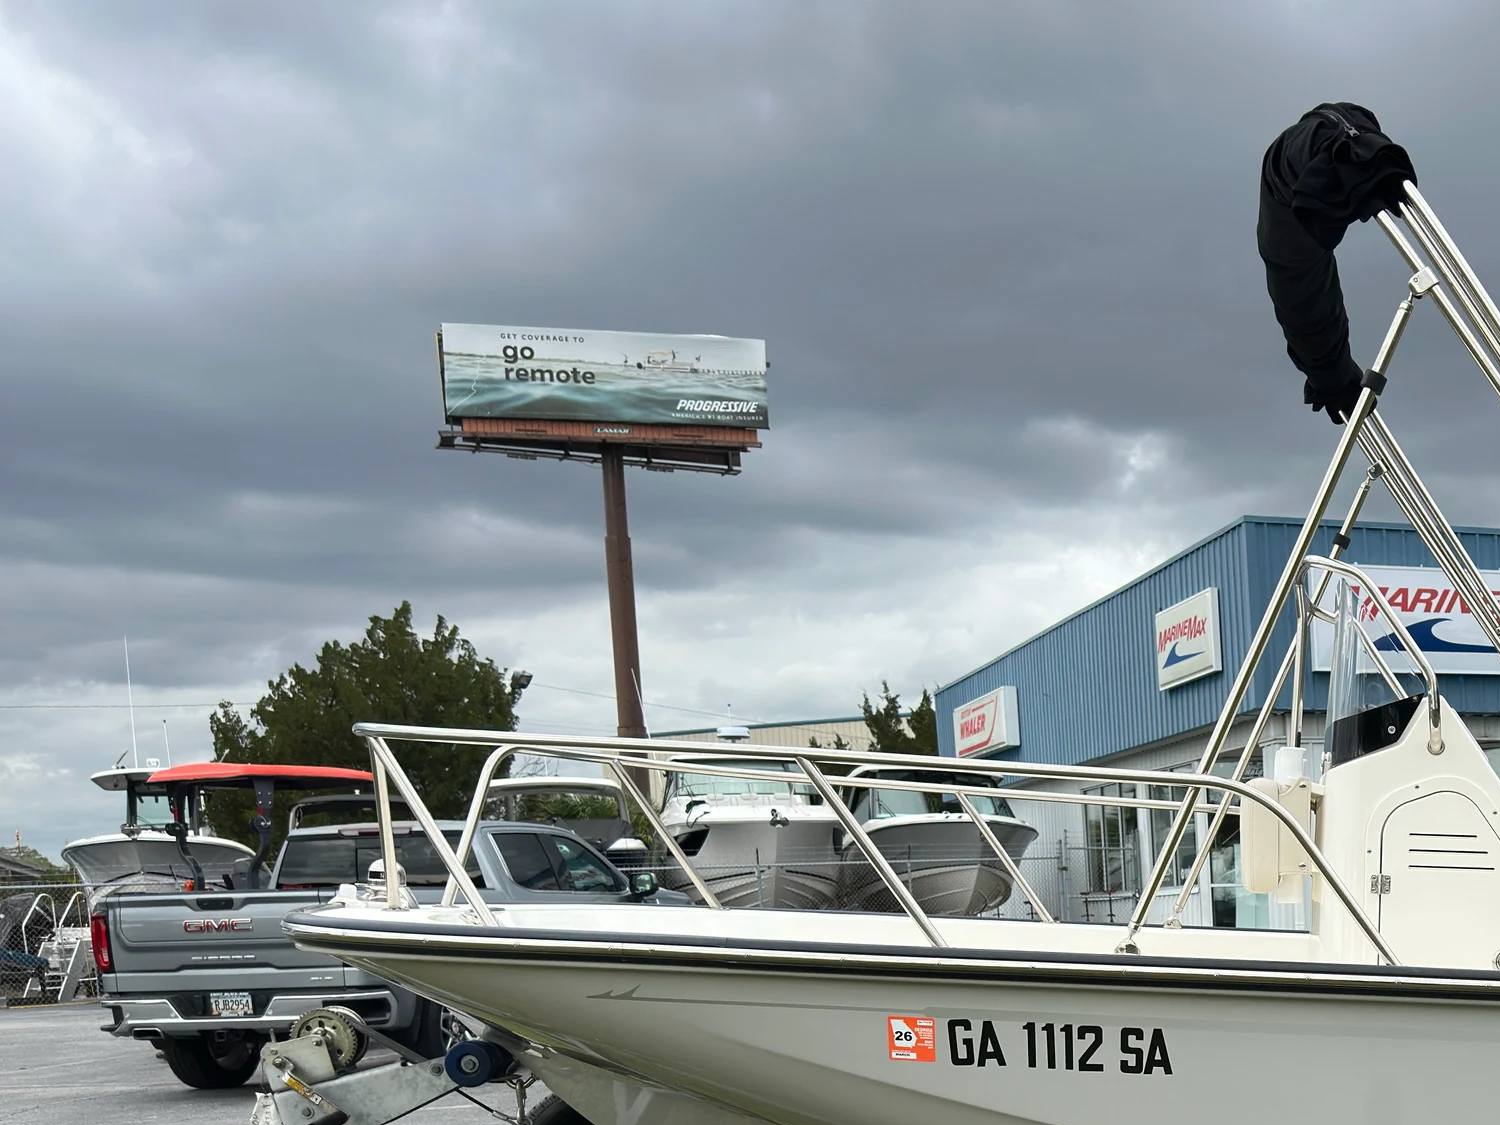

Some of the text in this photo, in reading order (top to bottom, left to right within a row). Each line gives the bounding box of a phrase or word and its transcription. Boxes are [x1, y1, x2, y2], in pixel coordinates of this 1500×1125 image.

[521, 334, 569, 342] COVERAGE
[502, 344, 535, 364] go
[504, 367, 596, 384] remote
[676, 399, 758, 413] PROGRESSIVE
[960, 712, 986, 741] WHALER
[183, 918, 253, 934] GMC
[214, 999, 250, 1011] RJB2954
[894, 1030, 913, 1042] 26
[947, 1018, 1173, 1075] GA 1112 SA
